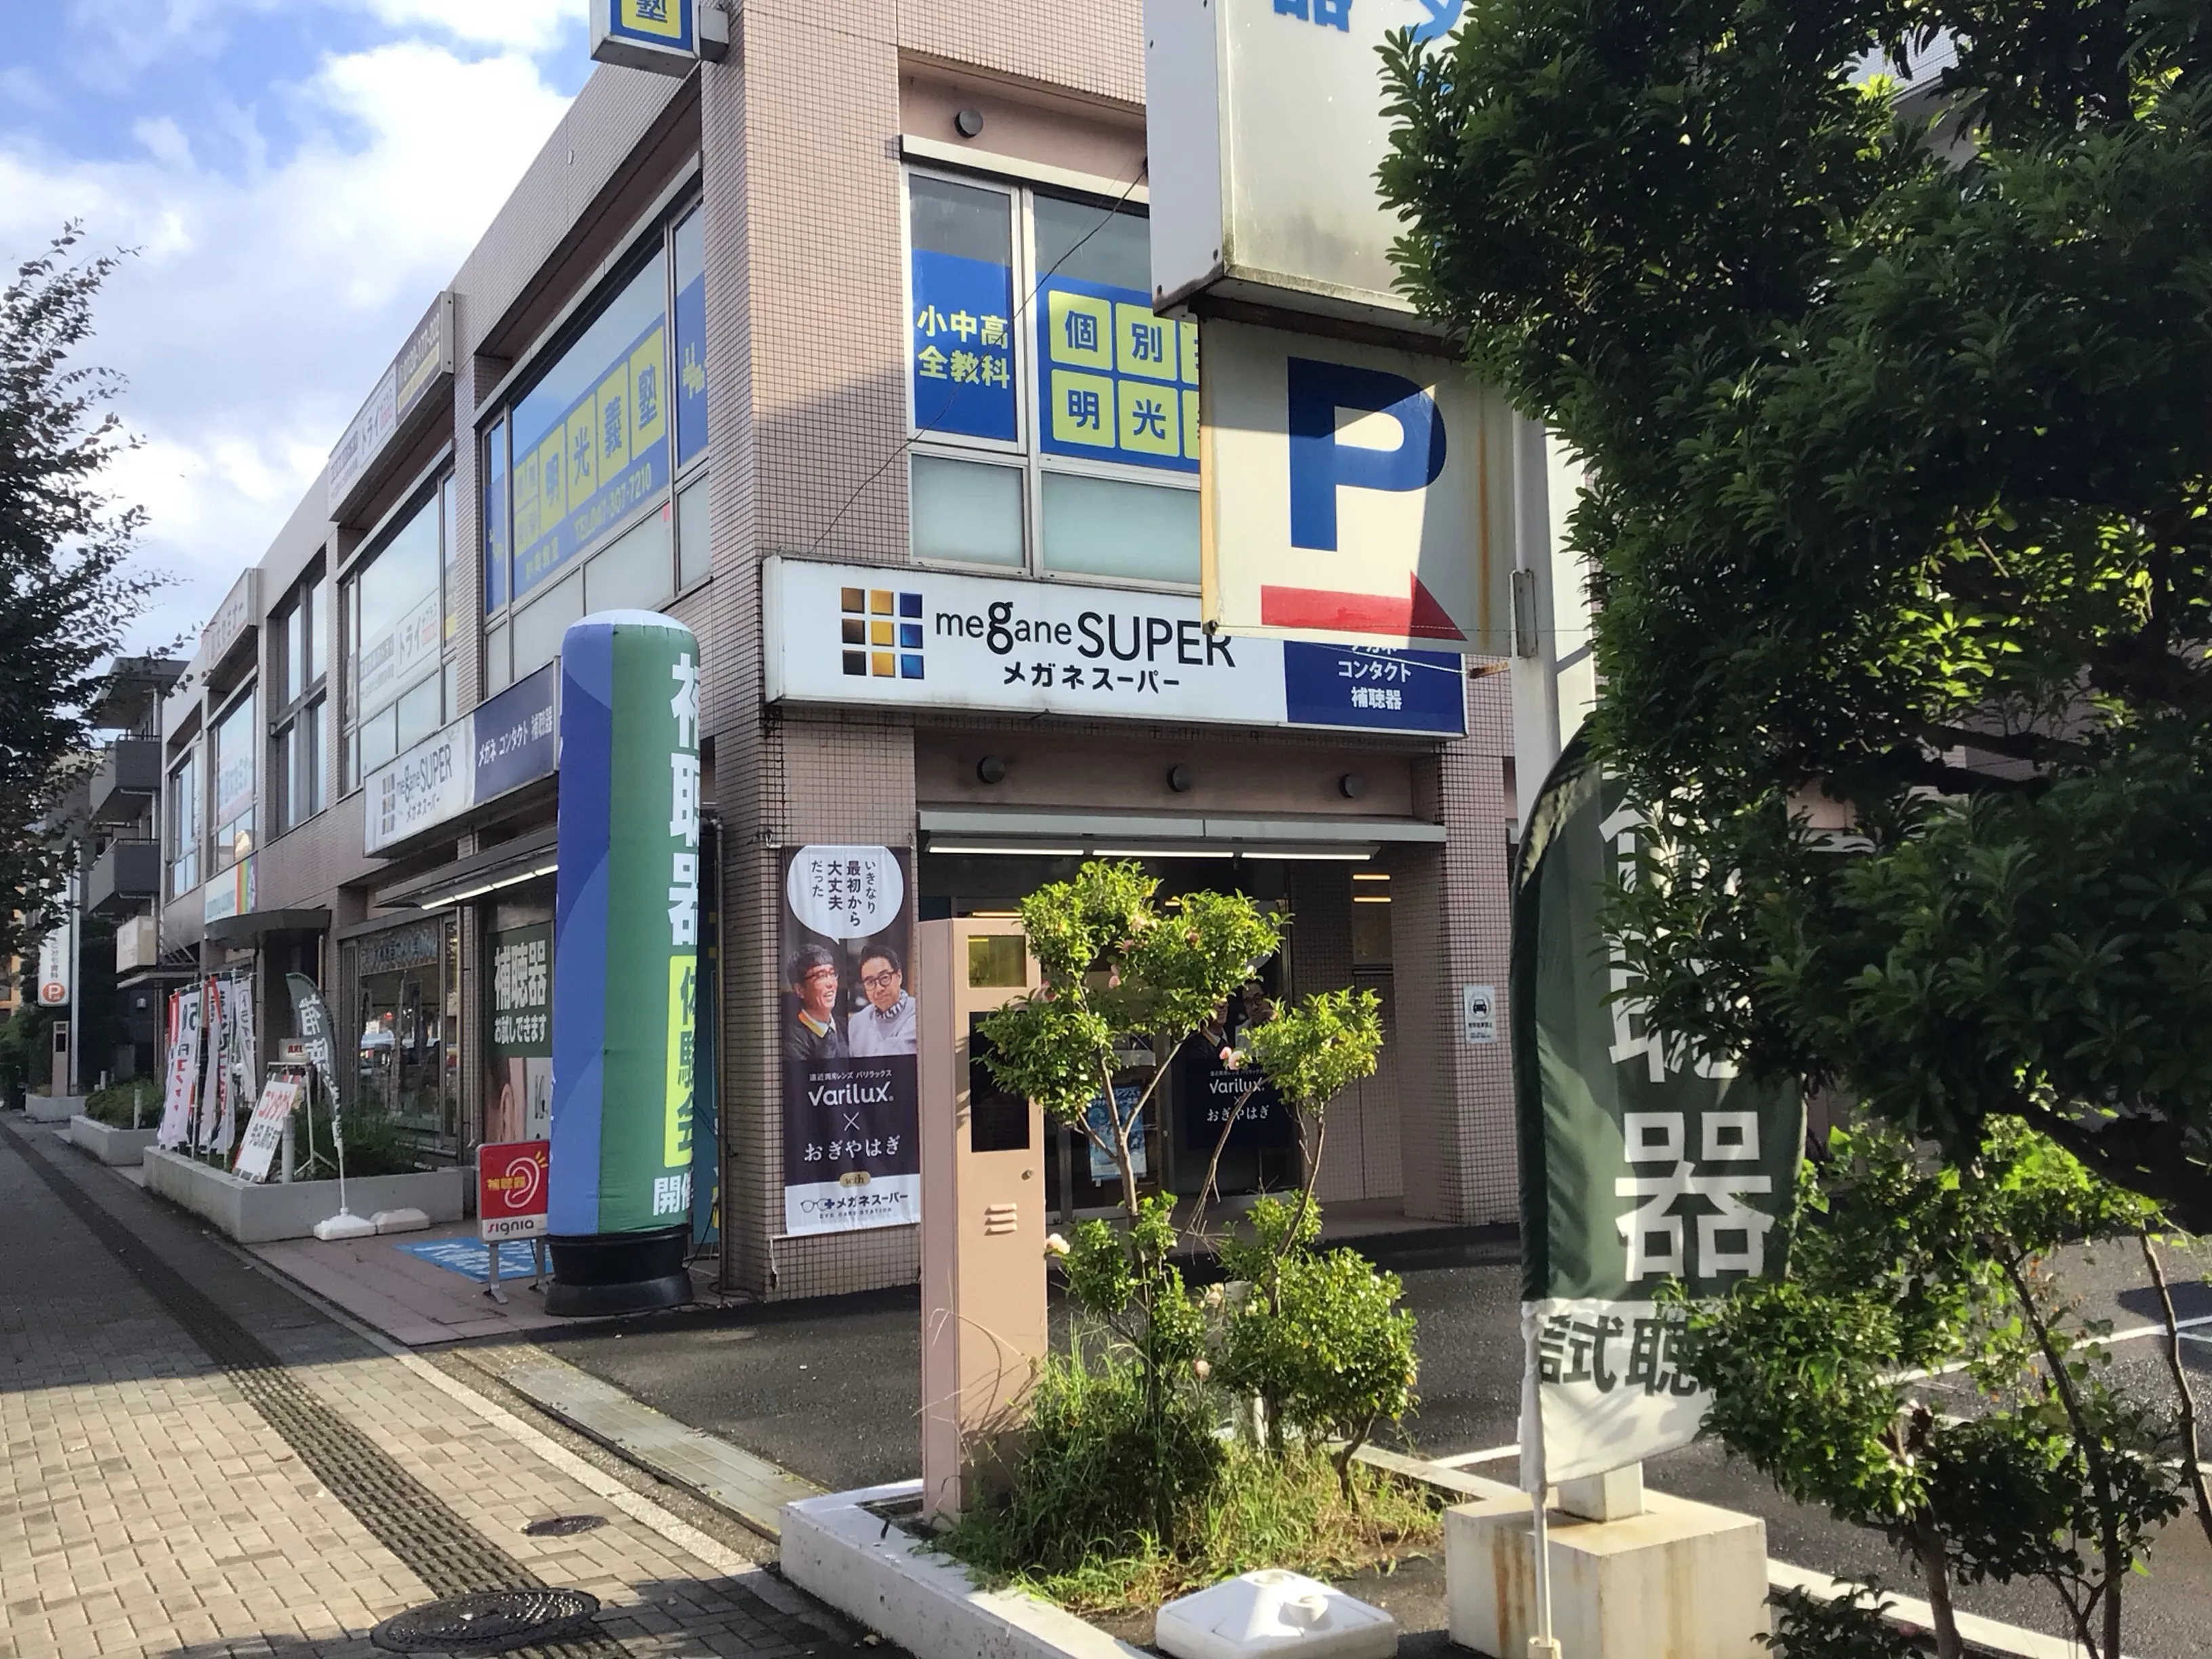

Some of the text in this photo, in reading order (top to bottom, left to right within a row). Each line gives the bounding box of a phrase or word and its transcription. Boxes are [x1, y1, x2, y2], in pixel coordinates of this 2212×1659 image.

[917, 304, 1008, 349] 小中高
[1065, 310, 1198, 369] 個別
[918, 345, 1010, 389] 全教科
[545, 363, 658, 507] 明光義塾
[1068, 390, 1199, 440] 明光
[1288, 356, 1447, 552] P
[1004, 661, 1181, 694] メガネスーパー
[1338, 660, 1412, 682] コンタクト
[1351, 686, 1403, 710] 補聴器
[478, 738, 497, 767] メガネ
[499, 720, 528, 756] コンタクト
[406, 797, 440, 823] メガネスーパー
[811, 859, 824, 898] だった
[827, 860, 843, 911] 大丈夫
[847, 860, 862, 926] 最初から
[865, 860, 876, 914] いきなり
[494, 940, 547, 1010] 補聴器
[494, 1013, 547, 1044] お試しできます
[856, 1069, 892, 1079] バリラックス
[804, 1134, 901, 1162] おぎやはぎ
[836, 1191, 908, 1209] メガネスーパー
